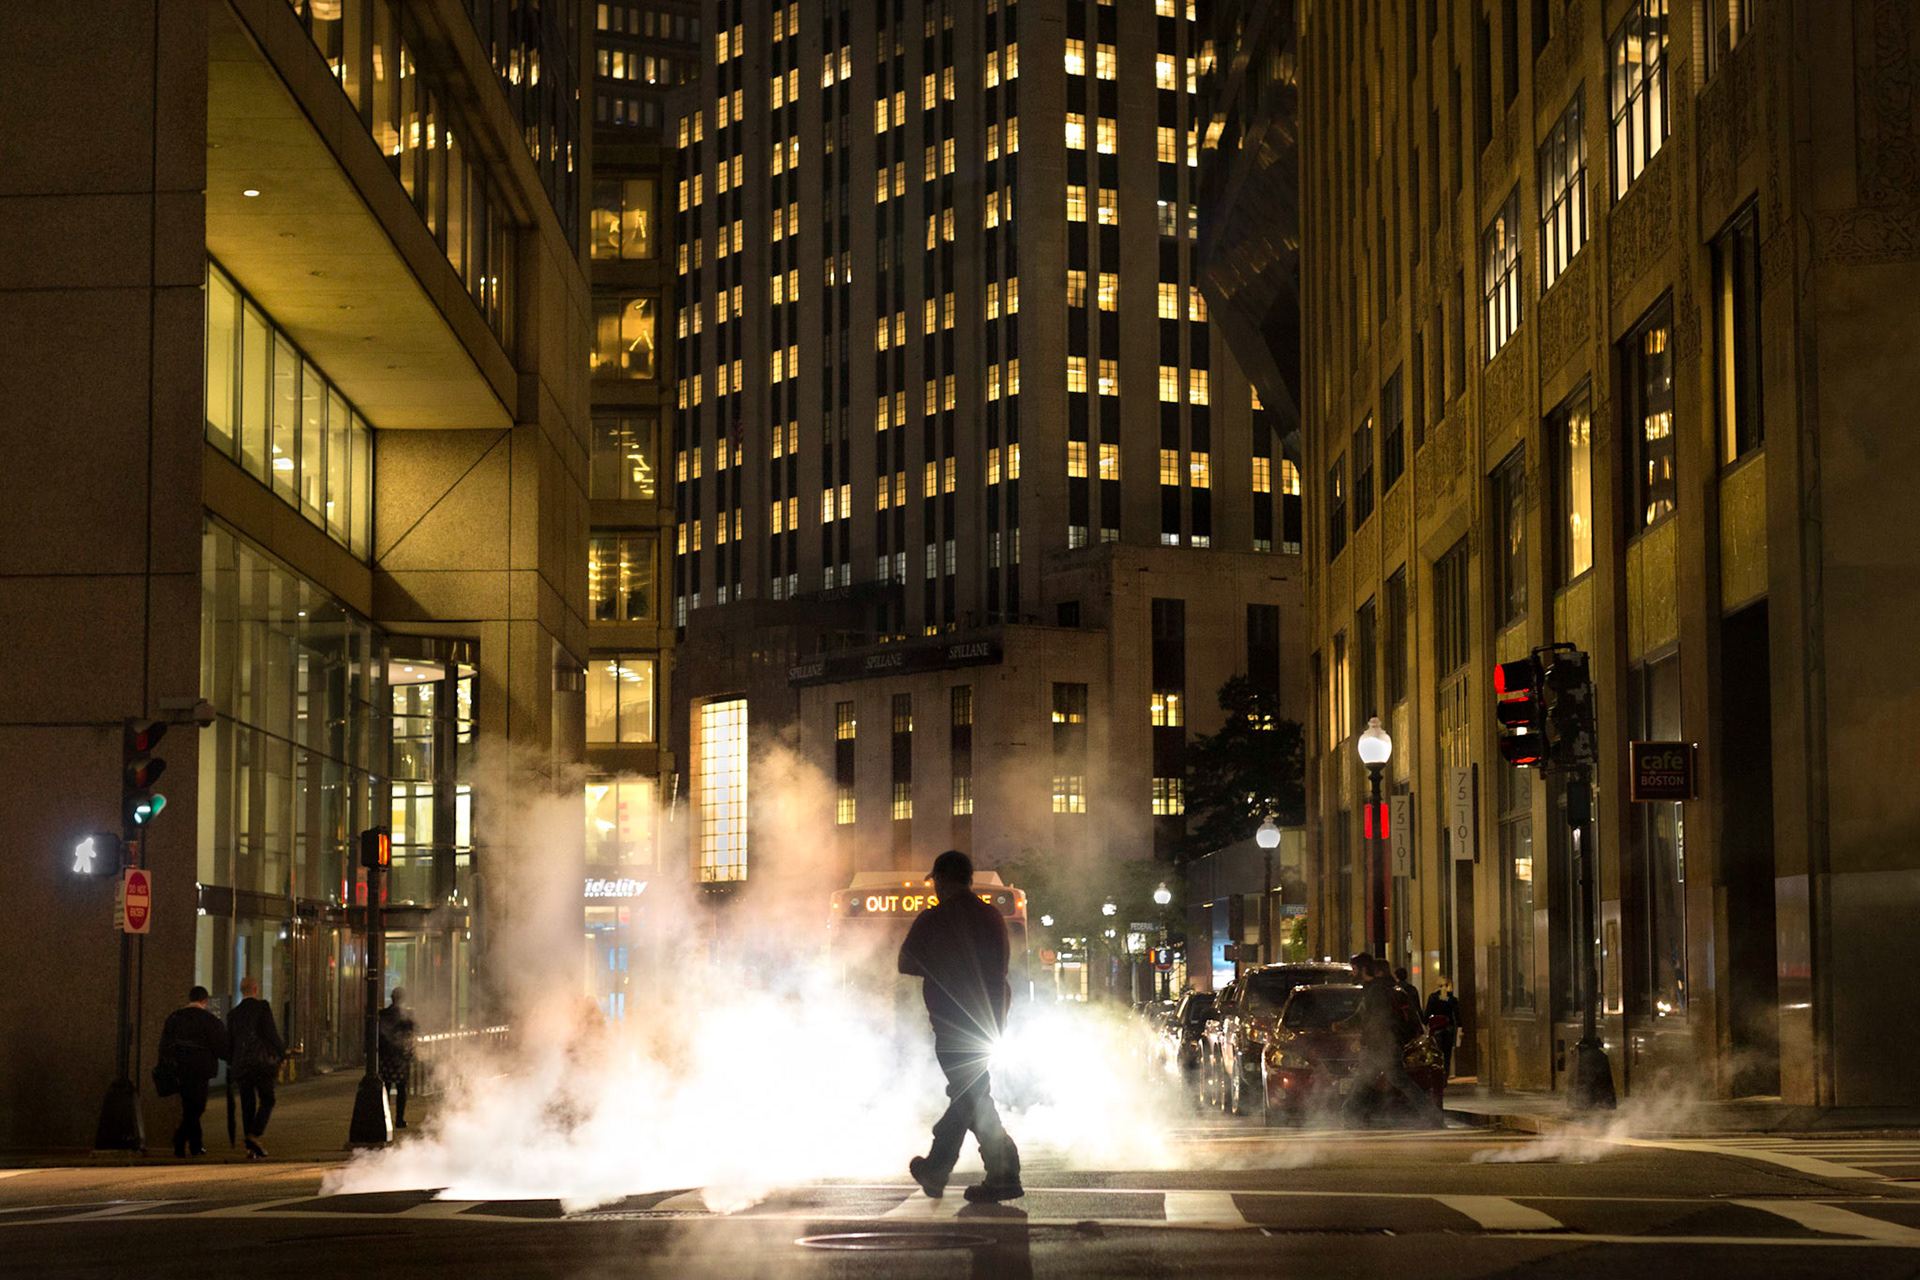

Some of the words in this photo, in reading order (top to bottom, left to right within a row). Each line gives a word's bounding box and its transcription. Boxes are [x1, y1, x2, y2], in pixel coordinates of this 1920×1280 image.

[948, 642, 989, 660] SPILLANE
[866, 653, 903, 670] SPILLANE
[788, 663, 823, 681] SPILLANE
[1641, 750, 1684, 770] café
[1641, 775, 1685, 786] BOSTON
[585, 878, 648, 897] idelity
[866, 896, 899, 912] OUT
[902, 895, 924, 911] OF
[1130, 922, 1154, 931] FEDERAL
